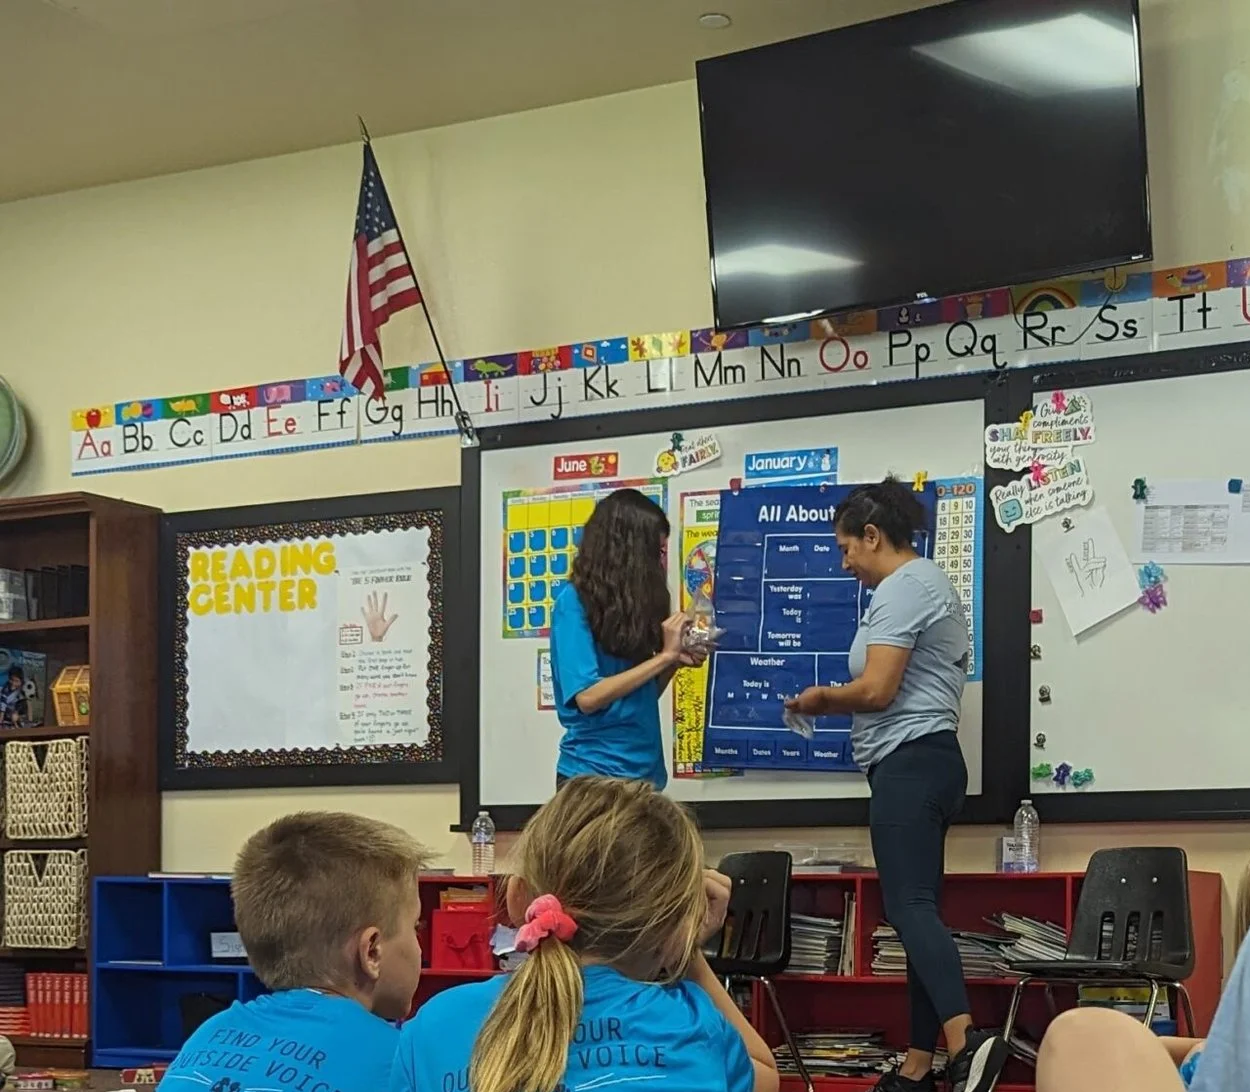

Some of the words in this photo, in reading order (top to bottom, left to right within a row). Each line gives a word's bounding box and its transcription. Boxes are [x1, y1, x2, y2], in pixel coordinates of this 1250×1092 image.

[78, 430, 112, 459] Aa
[123, 423, 153, 453] Bb
[170, 418, 204, 447] Cc
[219, 410, 252, 443] Dd
[266, 405, 297, 437] Ee
[317, 398, 352, 431] Ff
[365, 397, 403, 436] Gg
[418, 384, 453, 418] Hh
[483, 380, 500, 412] Ii
[530, 373, 563, 419] Jj
[583, 365, 619, 400] Kk
[694, 352, 745, 389] Mm
[761, 344, 801, 380] Nn
[819, 337, 868, 373] Oo
[889, 330, 931, 378] Pp
[946, 321, 1007, 370] Qq
[1023, 311, 1066, 349] Rr
[1095, 305, 1138, 341] Ss
[1168, 292, 1211, 332] Tt
[1032, 416, 1089, 429] compliments
[988, 428, 1028, 442] SHA
[1032, 426, 1092, 444] FREELY.
[557, 458, 587, 473] June
[748, 455, 808, 472] January
[994, 485, 1025, 503] Really
[1025, 492, 1045, 505] when
[1048, 478, 1082, 496] someone
[690, 499, 705, 507] The
[941, 502, 946, 511] 8
[954, 503, 959, 511] 9
[965, 500, 973, 510] 10
[1025, 507, 1042, 518] else
[1045, 502, 1053, 510] is
[1056, 490, 1087, 506] talking
[702, 511, 720, 520] spri
[758, 505, 780, 522] All
[785, 505, 836, 522] About
[939, 516, 947, 526] 18
[952, 515, 960, 525] 19
[964, 514, 973, 524] 20
[686, 530, 700, 538] The
[938, 530, 947, 541] 28
[951, 530, 959, 540] 29
[964, 529, 973, 539] 30
[937, 545, 946, 556] 38
[950, 544, 959, 555] 39
[963, 543, 972, 553] 40
[190, 542, 337, 583] READING
[950, 559, 959, 569] 49
[963, 558, 972, 568] 50
[769, 585, 803, 593] Yesterday
[963, 588, 971, 598] 70
[189, 578, 317, 616] CENTER
[782, 608, 802, 616] Today
[750, 657, 785, 666] Weather
[743, 680, 762, 688] Today
[573, 1017, 624, 1045] OUR
[208, 1029, 261, 1048] FIND
[267, 1038, 327, 1070] YOUR
[577, 1045, 667, 1069] VOICE
